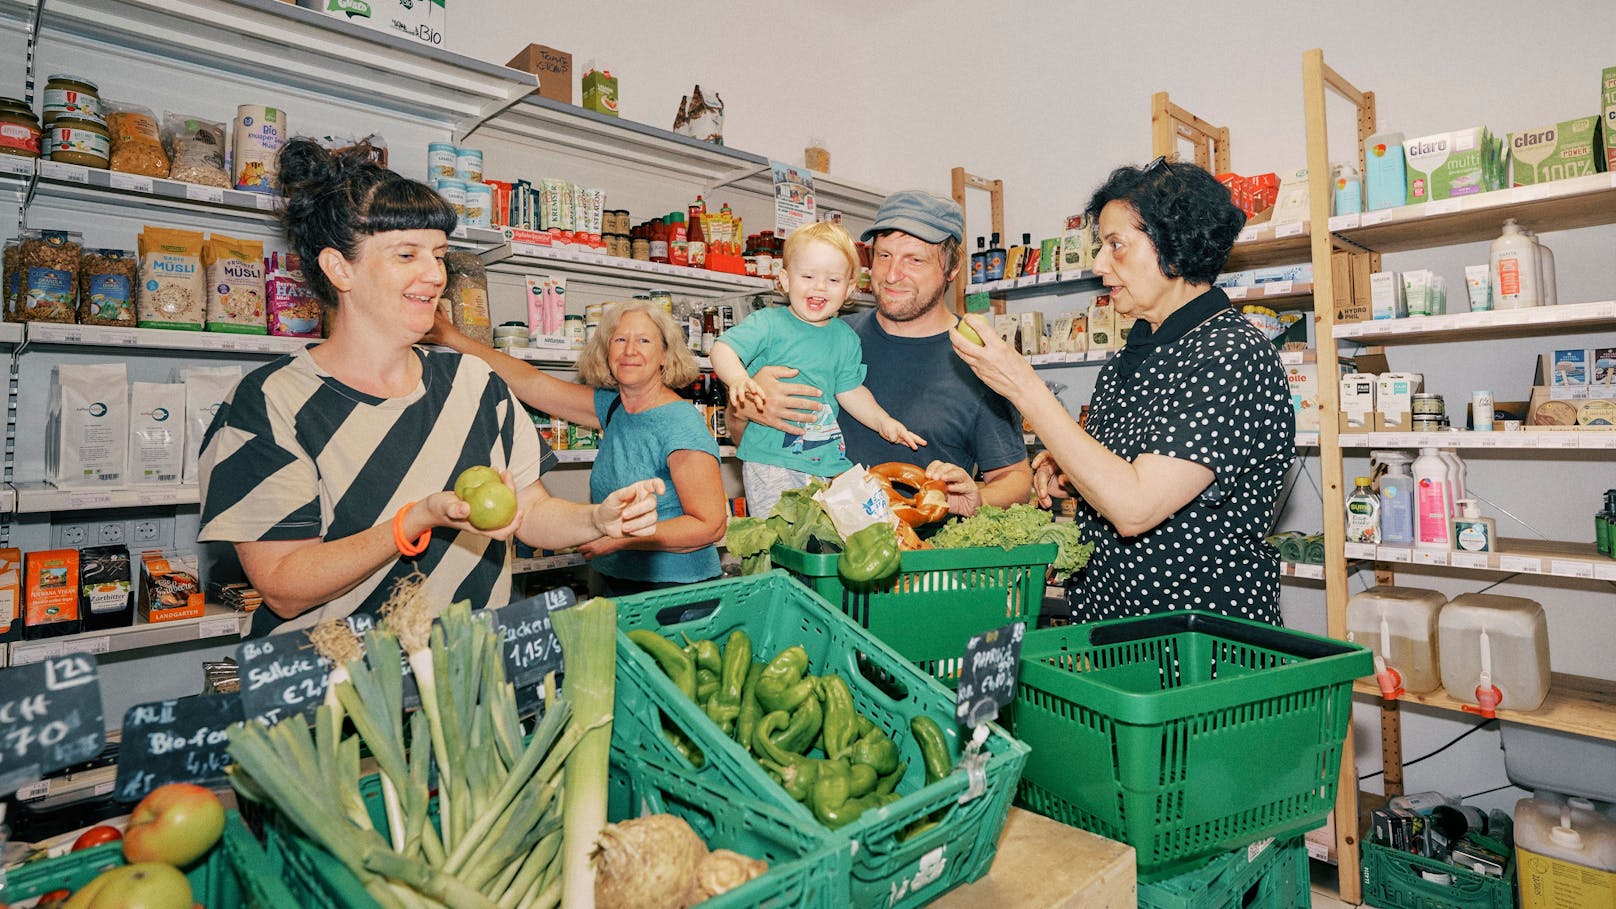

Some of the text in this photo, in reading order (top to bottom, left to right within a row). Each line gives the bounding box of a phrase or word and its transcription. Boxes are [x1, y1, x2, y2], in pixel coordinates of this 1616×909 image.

[420, 24, 442, 44] Bio
[263, 125, 277, 136] Bio
[1514, 130, 1554, 148] claro
[1410, 140, 1446, 156] claro
[1563, 148, 1587, 157] POWER
[153, 260, 195, 273] MÜSLI
[224, 265, 261, 278] MÜSLI
[1345, 306, 1367, 314] HYDRO
[1288, 375, 1307, 383] olle
[155, 609, 199, 620] LANDGARTEN
[498, 616, 551, 642] Zuckerm
